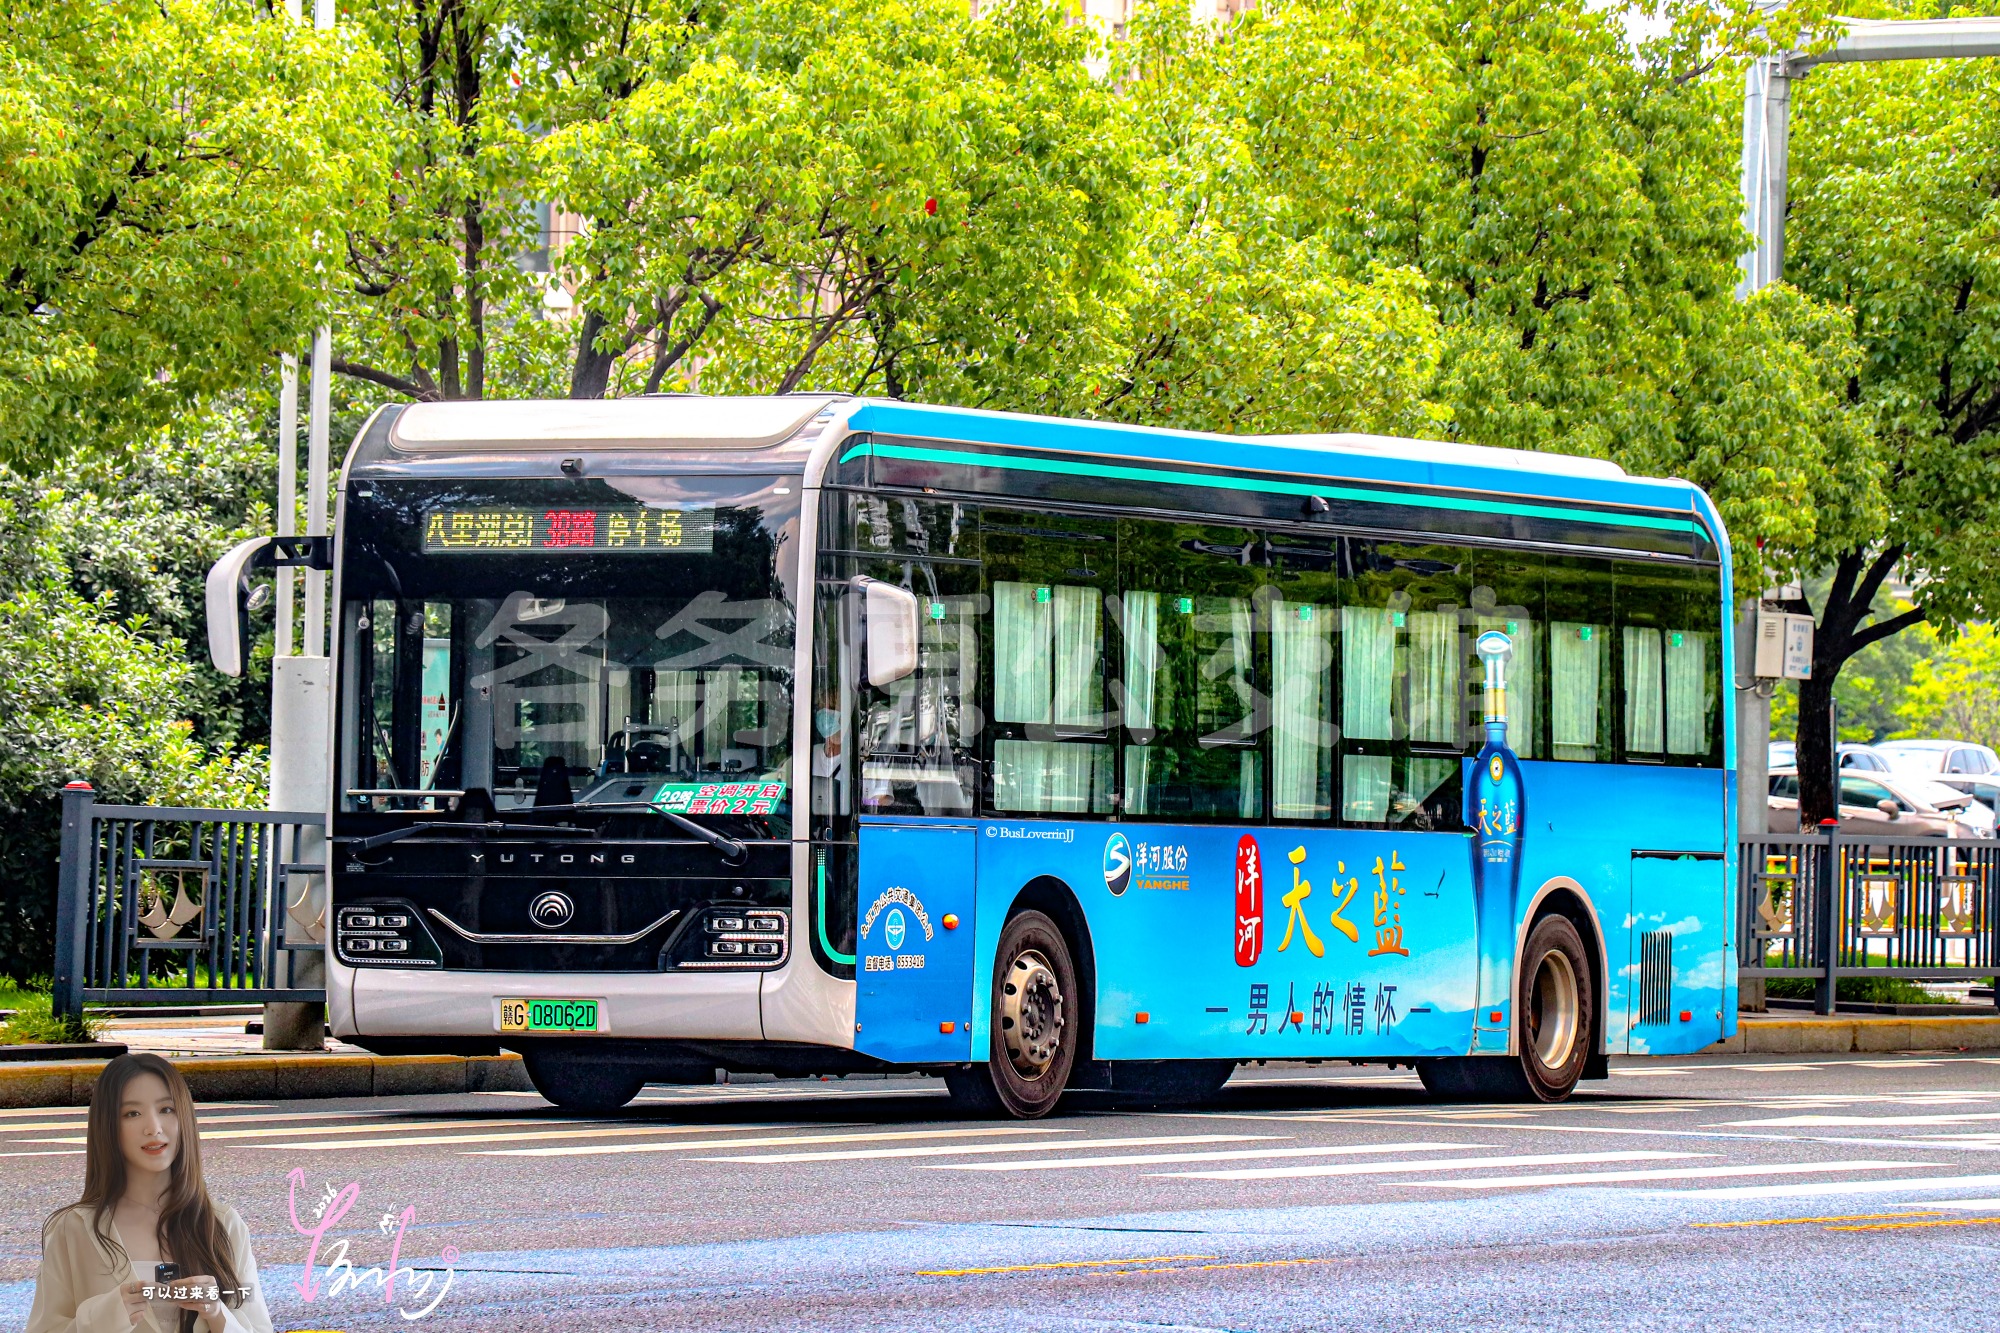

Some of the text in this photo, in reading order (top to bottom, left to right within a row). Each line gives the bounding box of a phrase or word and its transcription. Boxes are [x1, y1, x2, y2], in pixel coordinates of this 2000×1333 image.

[608, 511, 682, 547] 停车场
[696, 784, 780, 798] 空调开启
[687, 799, 771, 815] 票价2元
[471, 854, 635, 863] YUTONG
[1135, 842, 1188, 875] 洋河股份
[1136, 880, 1190, 890] YANGHE
[1237, 845, 1261, 962] 洋河
